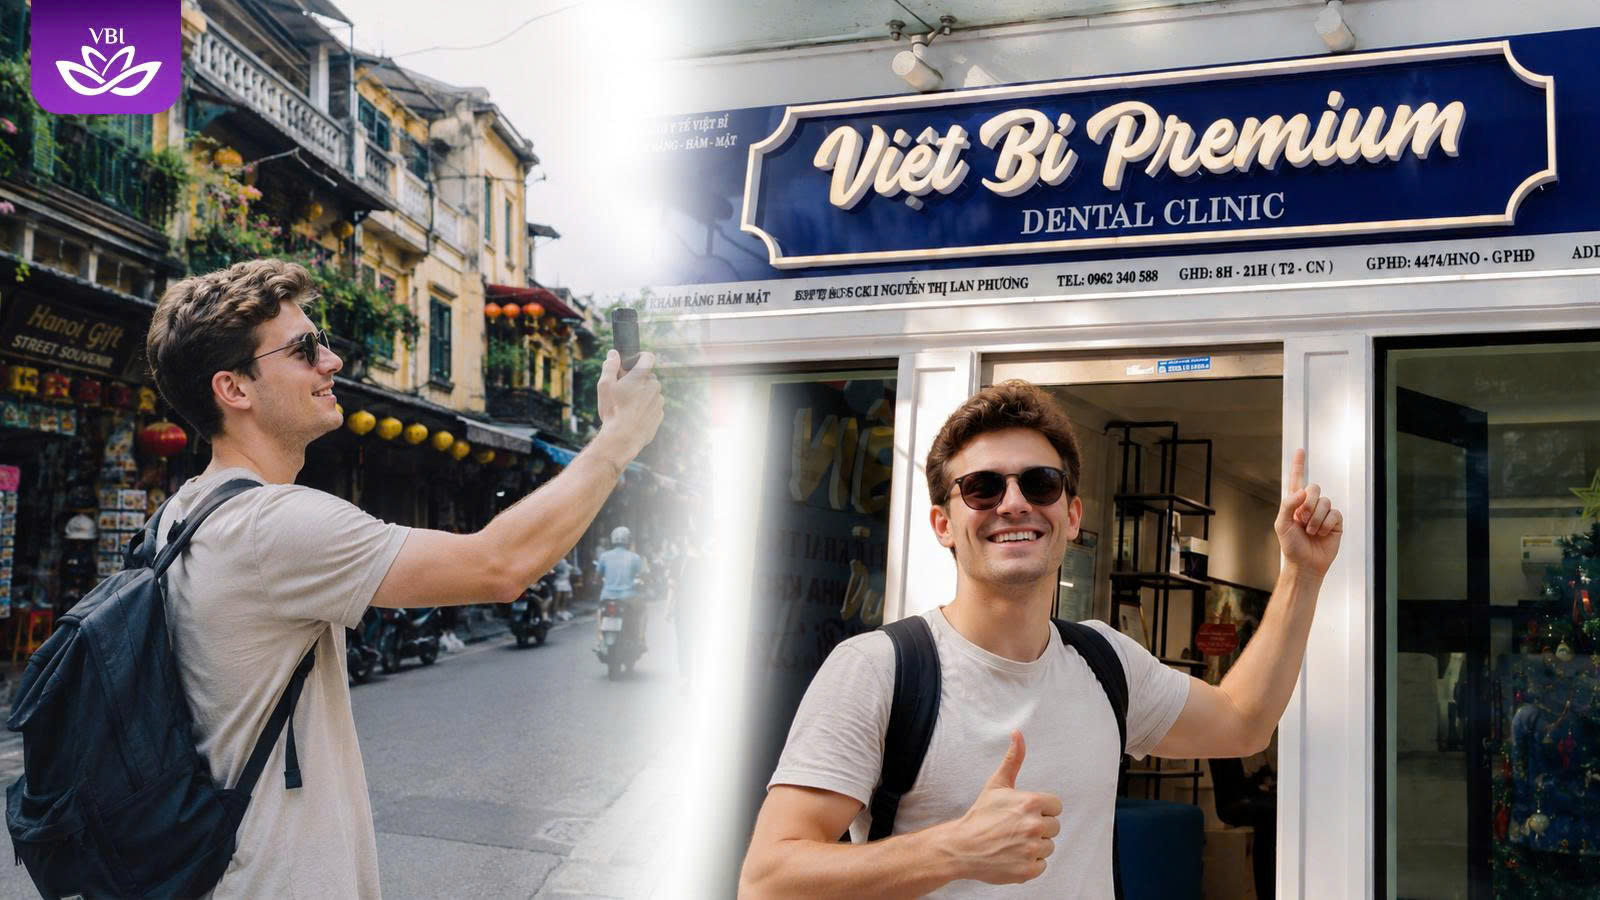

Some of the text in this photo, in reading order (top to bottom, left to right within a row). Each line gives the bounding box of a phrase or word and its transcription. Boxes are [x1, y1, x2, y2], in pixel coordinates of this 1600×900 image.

[813, 124, 971, 212] Việt
[1086, 90, 1466, 191] Premium
[1020, 192, 1285, 235] DENTAL CLINIC
[1414, 251, 1480, 269] 4474/HNO
[1056, 269, 1159, 288] TEL: 0962 340 588
[1215, 265, 1233, 279] 8H
[1243, 264, 1268, 278] 21H
[949, 280, 975, 293] LAN
[977, 276, 1029, 292] PHƯƠNG
[27, 304, 125, 352] Hanoi Gift
[11, 334, 60, 356] STREET
